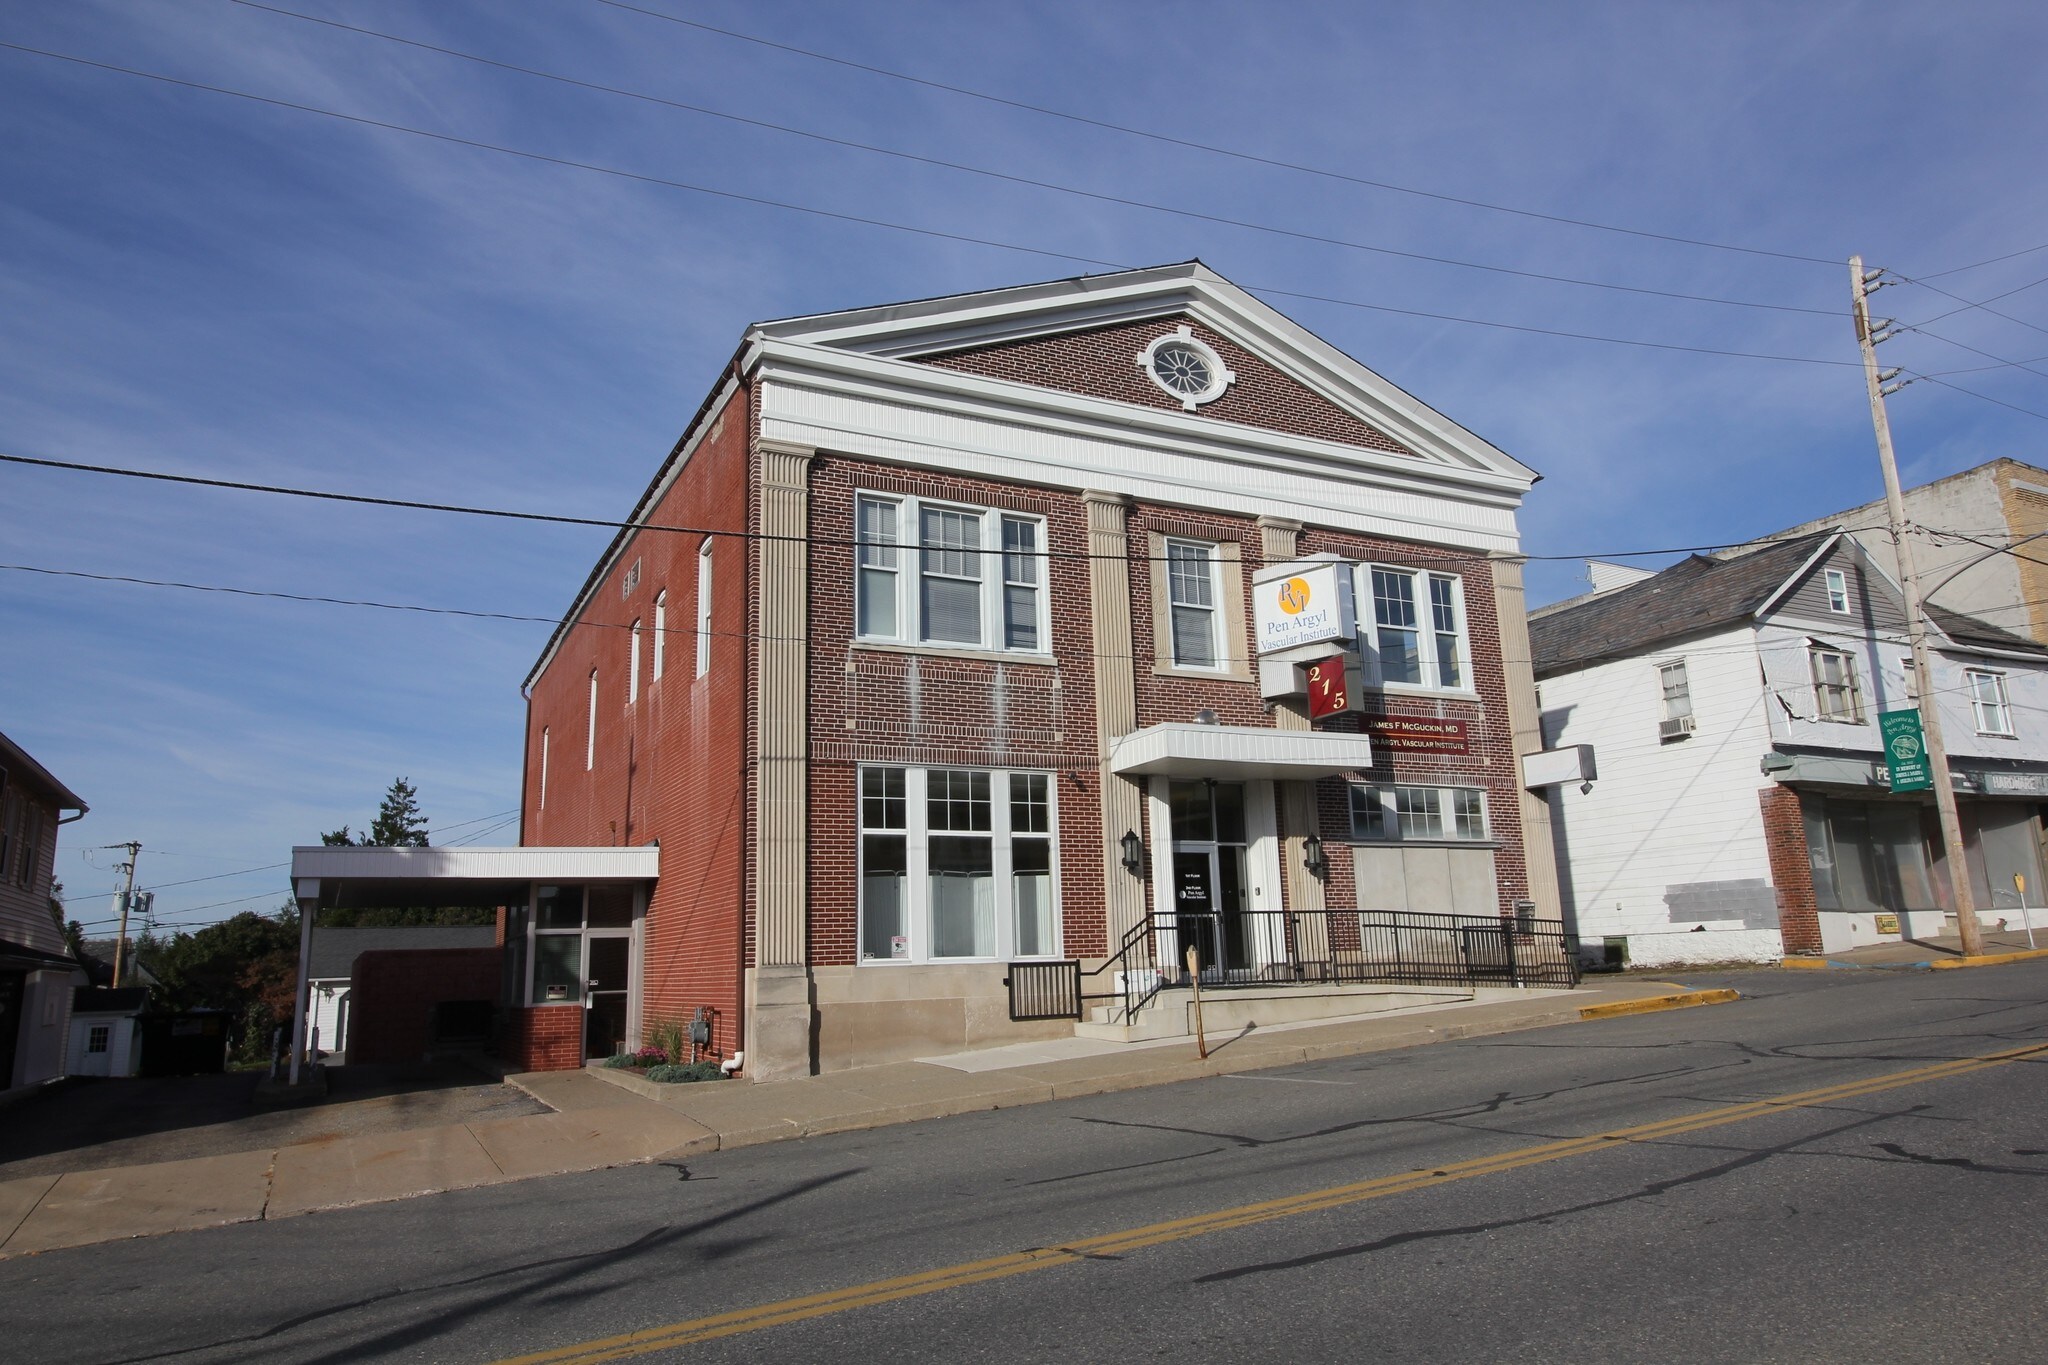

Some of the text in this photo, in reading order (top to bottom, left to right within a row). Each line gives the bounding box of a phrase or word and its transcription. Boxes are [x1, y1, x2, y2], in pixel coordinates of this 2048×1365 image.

[1267, 609, 1328, 635] Pen Argyl
[1260, 626, 1337, 650] Vascular Institute
[1309, 666, 1345, 710] 215
[1369, 720, 1394, 729] JAMES
[1395, 721, 1401, 729] F
[1445, 724, 1459, 733] MD
[1370, 738, 1465, 750] EN ARGYL VASCULAR INSTITUTE
[1992, 775, 2036, 790] HARDWARE
